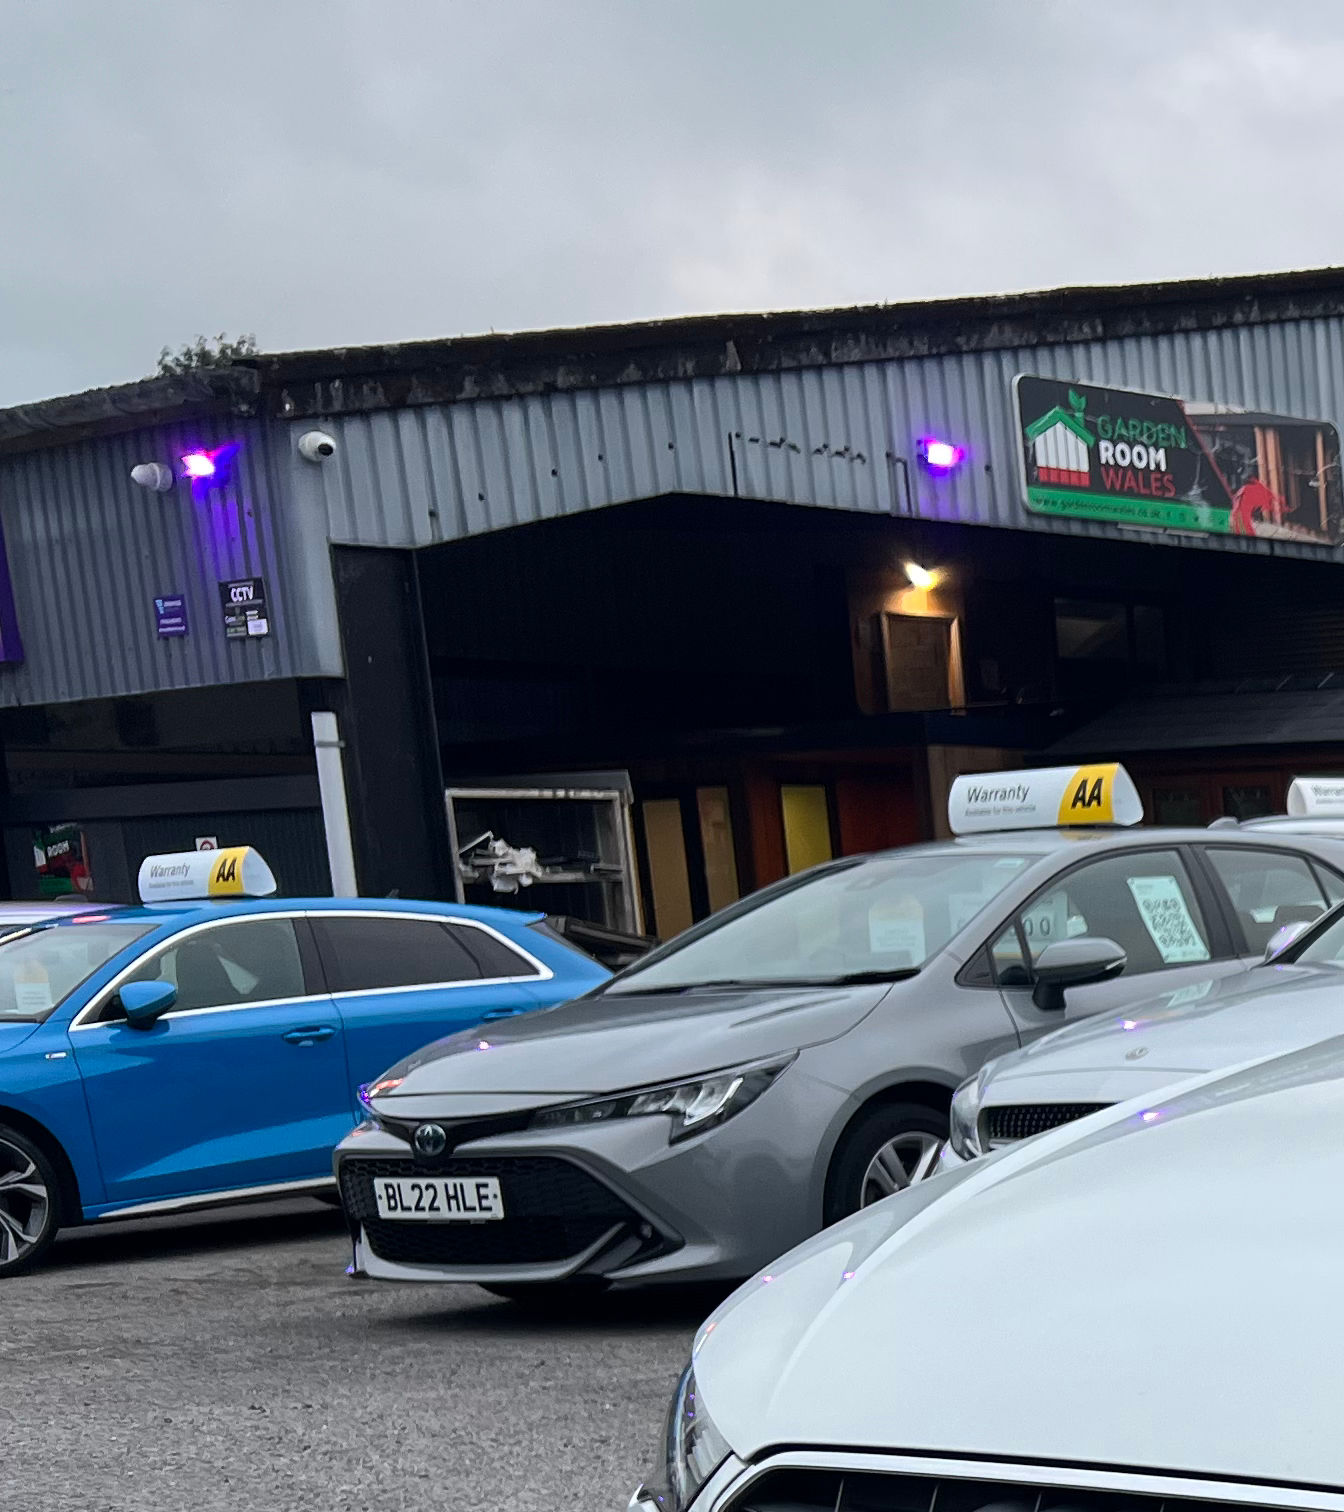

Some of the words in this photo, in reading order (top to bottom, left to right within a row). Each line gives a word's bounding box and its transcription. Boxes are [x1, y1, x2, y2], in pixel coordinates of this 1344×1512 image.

[1096, 415, 1188, 449] GARDEN
[1099, 439, 1167, 472] ROOM
[1101, 466, 1177, 498] WALES
[230, 585, 254, 602] CCTV
[966, 783, 1031, 804] Warranty
[1070, 777, 1103, 810] AA
[150, 862, 191, 879] Warranty
[215, 857, 238, 884] AA
[384, 1182, 441, 1212] BL22
[444, 1182, 493, 1212] HLE
